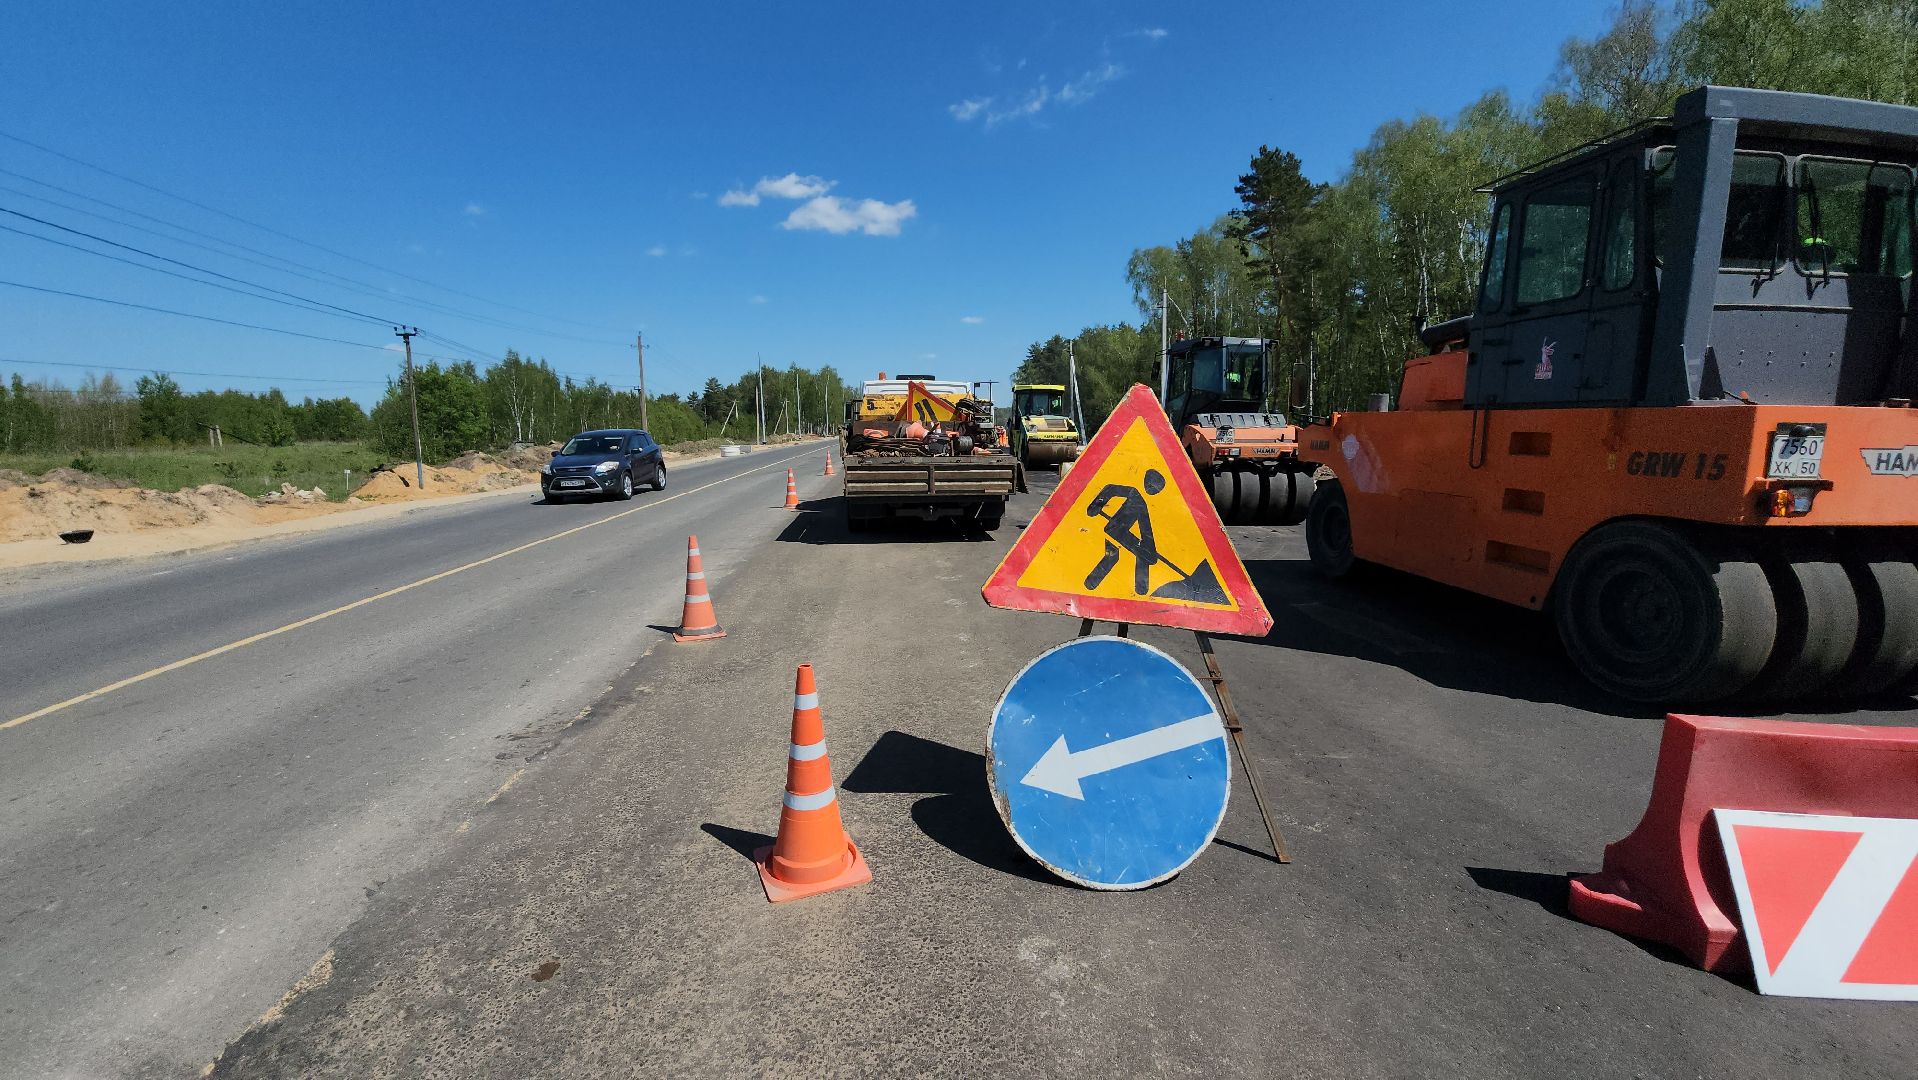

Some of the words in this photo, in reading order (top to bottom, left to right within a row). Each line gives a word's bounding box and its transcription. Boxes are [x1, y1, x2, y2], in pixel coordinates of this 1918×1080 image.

[1780, 438, 1818, 456] 7560
[1626, 451, 1686, 478] GRW
[1695, 453, 1729, 481] 15
[1800, 461, 1816, 474] 50
